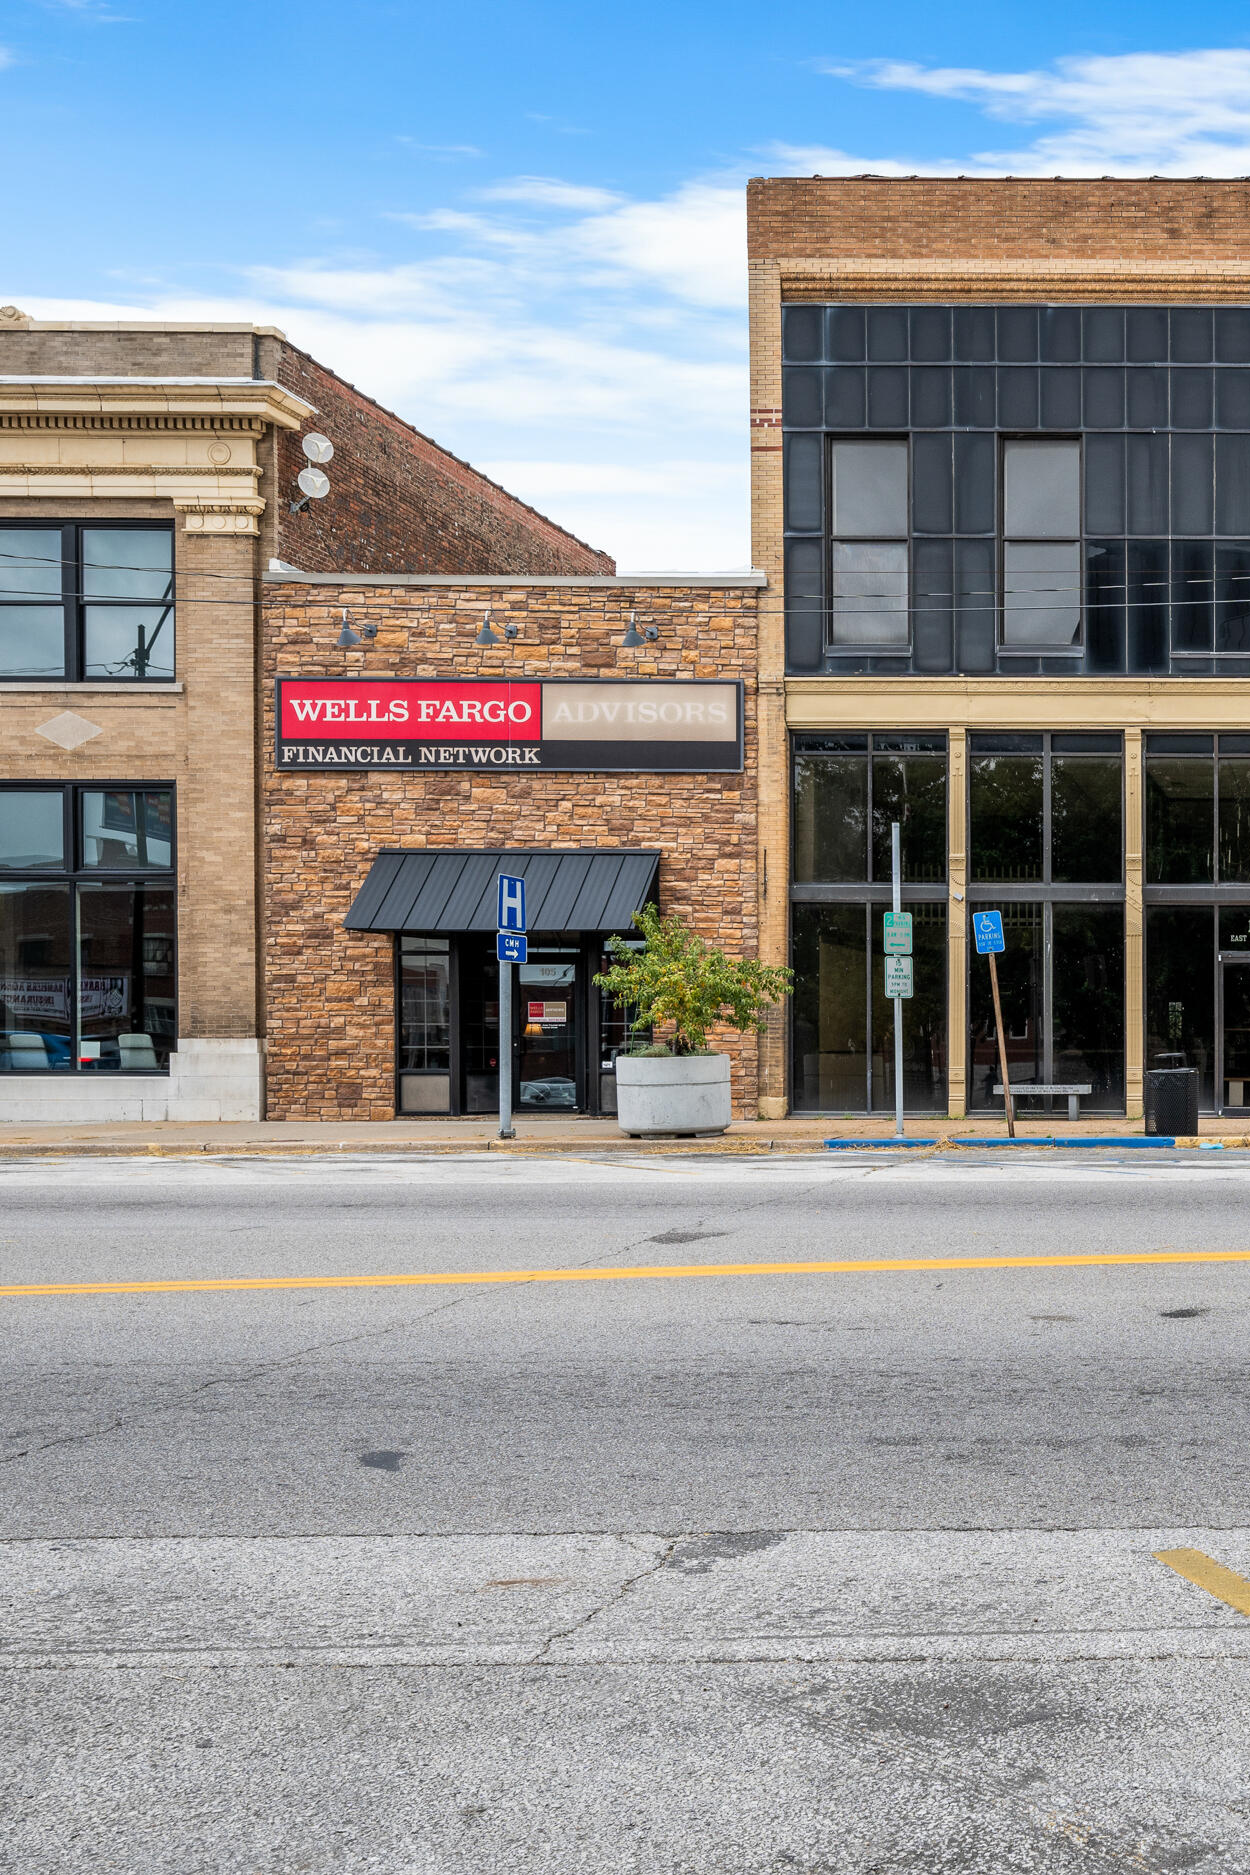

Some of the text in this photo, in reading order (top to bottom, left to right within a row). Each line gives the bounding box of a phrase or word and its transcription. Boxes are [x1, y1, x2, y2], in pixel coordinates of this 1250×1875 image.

[290, 700, 728, 724] WELLS FARGO ADVISORS
[282, 746, 541, 764] FINANCIAL NETWORK
[502, 878, 523, 929] H
[504, 938, 520, 948] CMH
